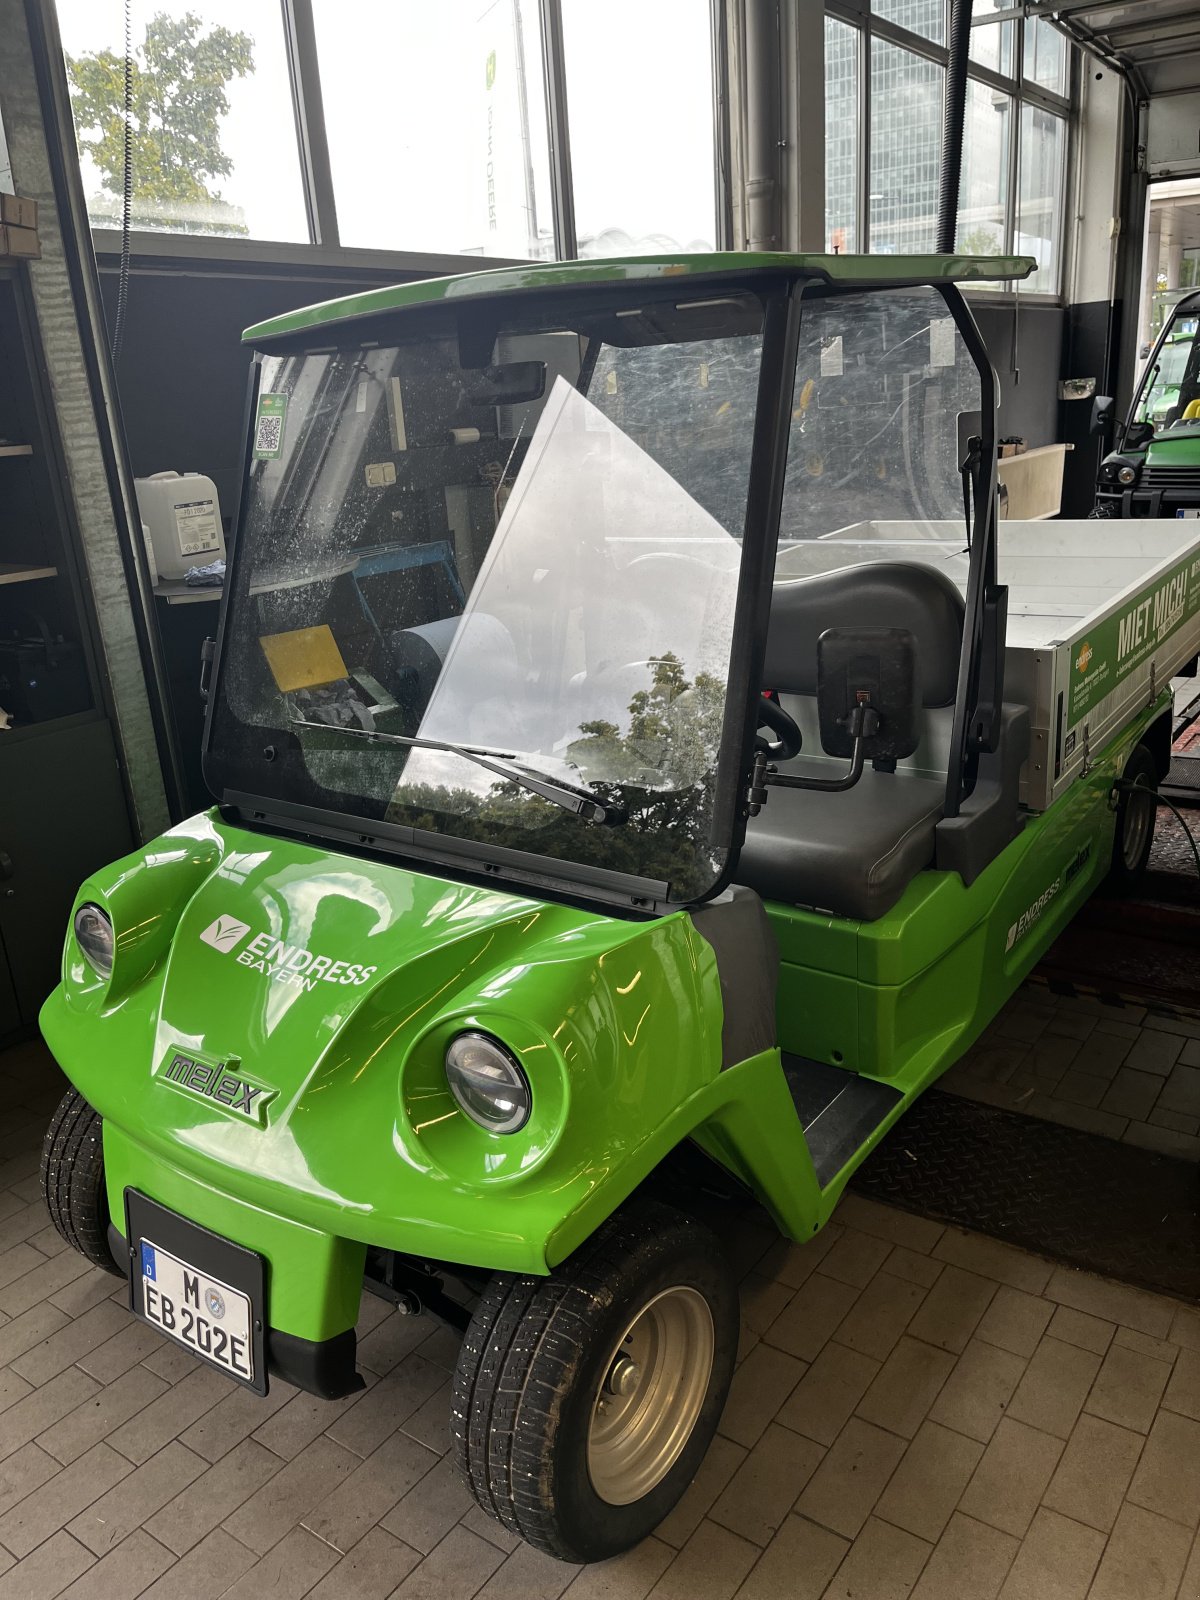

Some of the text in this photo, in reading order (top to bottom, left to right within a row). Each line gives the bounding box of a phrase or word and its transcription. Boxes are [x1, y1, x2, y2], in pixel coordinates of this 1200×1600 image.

[1117, 596, 1152, 662] MIET
[1153, 567, 1189, 632] MICH!
[1017, 877, 1061, 932] ENDRESS
[236, 951, 318, 992] BAYERN
[247, 932, 377, 985] ENDRESS
[165, 1054, 262, 1115] melex
[183, 1269, 200, 1309] M
[146, 1282, 249, 1376] EB 202E
